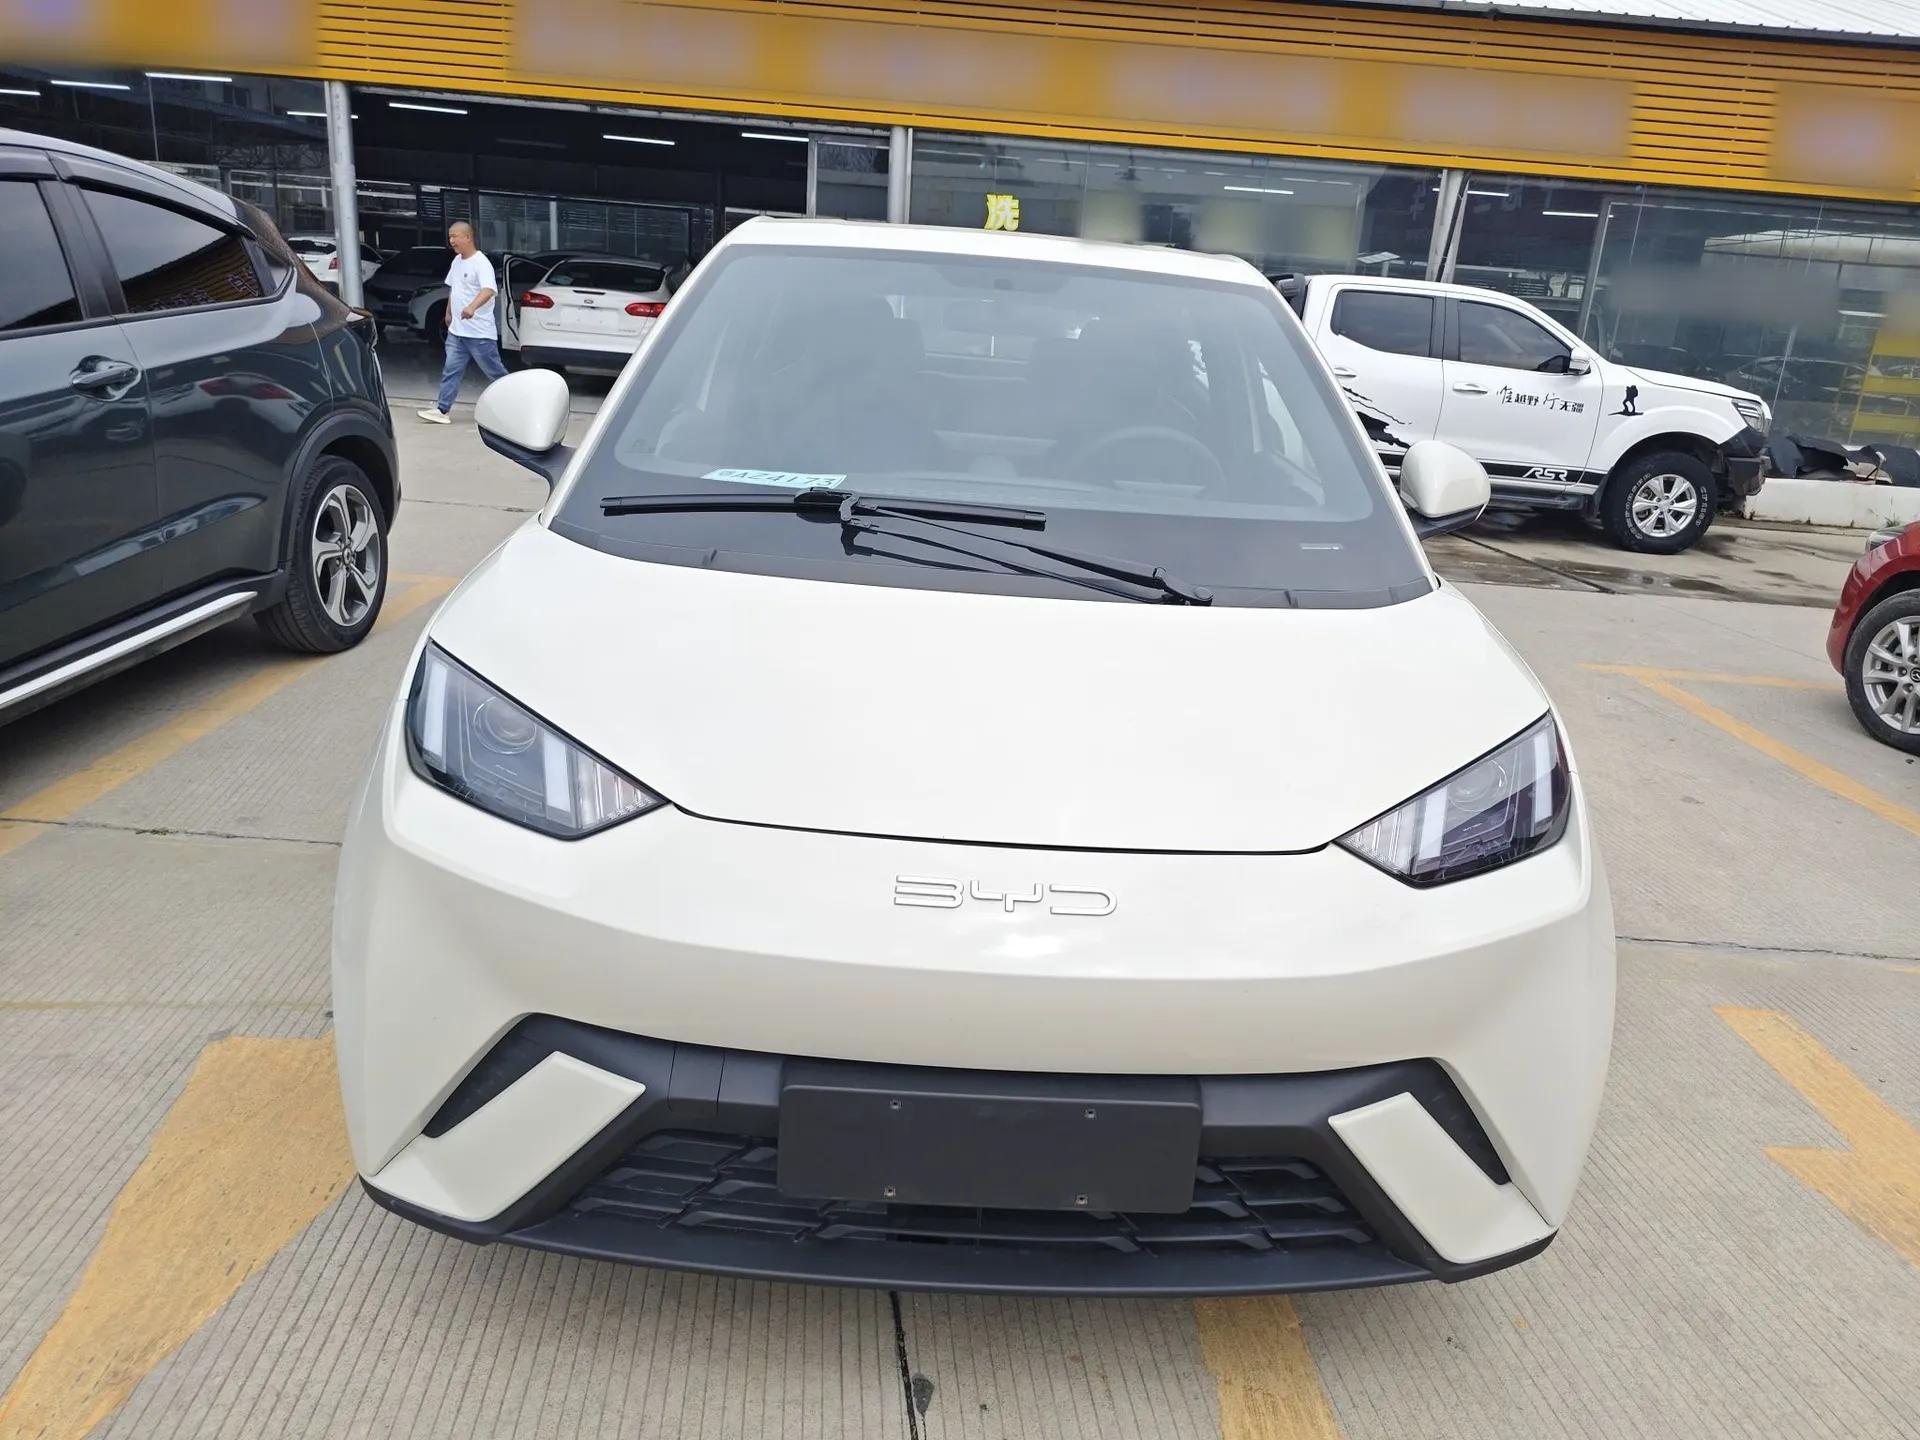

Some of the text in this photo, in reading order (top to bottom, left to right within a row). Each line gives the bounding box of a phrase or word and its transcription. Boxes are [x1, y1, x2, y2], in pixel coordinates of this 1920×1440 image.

[984, 194, 1020, 231] 洗
[719, 470, 836, 486] AZ4173
[1522, 467, 1568, 481] RSR
[894, 874, 1118, 917] BYD
